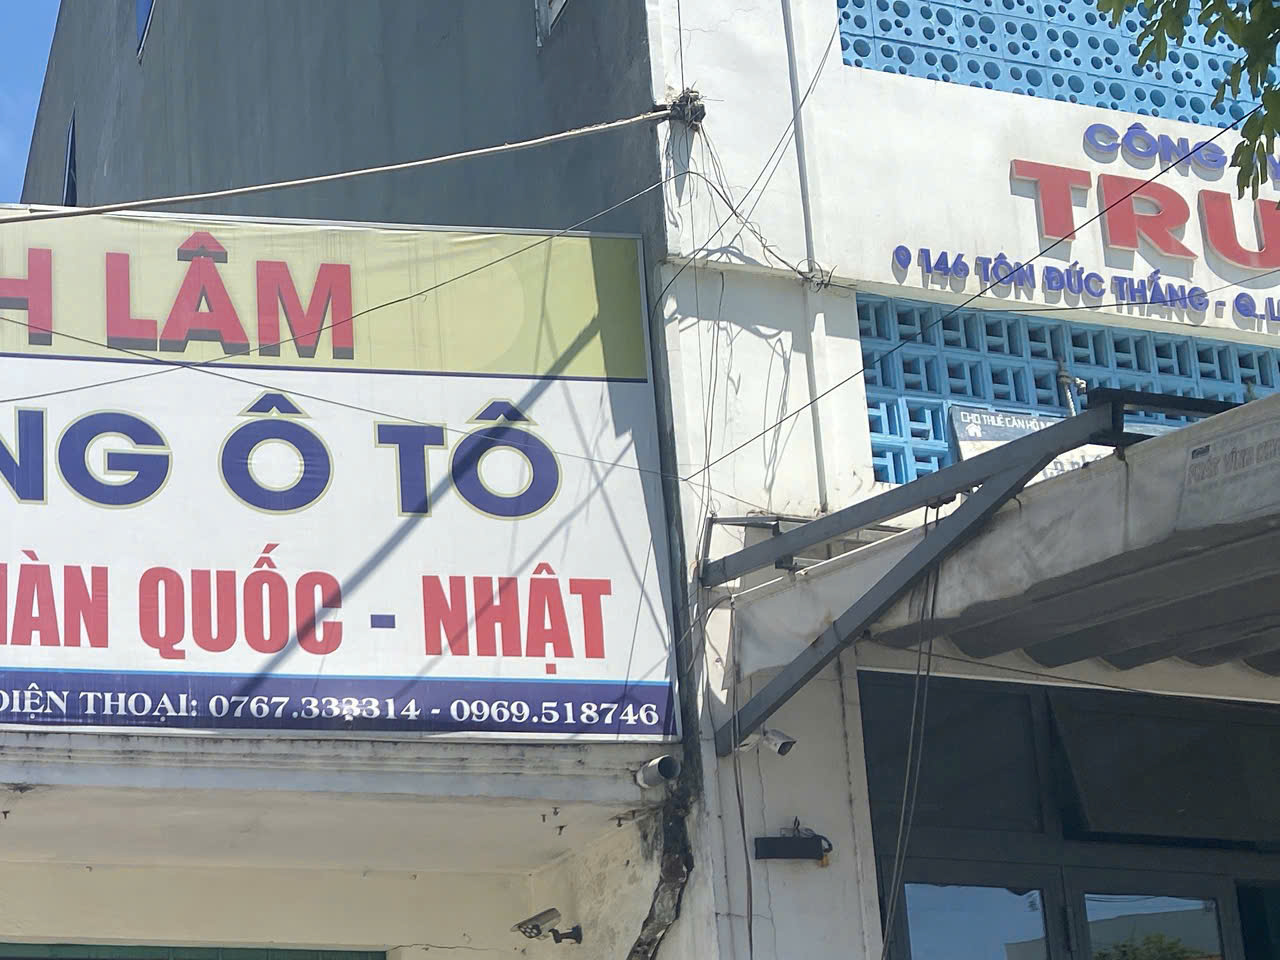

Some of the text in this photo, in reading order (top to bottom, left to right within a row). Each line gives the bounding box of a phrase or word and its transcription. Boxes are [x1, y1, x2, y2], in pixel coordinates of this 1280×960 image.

[1083, 121, 1228, 173] CÔNG
[105, 231, 355, 360] LÂM
[918, 248, 970, 279] 146
[975, 252, 1036, 289] TÔN
[1043, 261, 1107, 298] ĐỨC
[1113, 268, 1209, 312] THẮNG
[218, 389, 334, 514] Ô
[374, 398, 563, 520] TÔ
[138, 542, 343, 659] QUỐC
[422, 562, 612, 675] NHẬT
[79, 691, 198, 722] THOẠI:
[450, 699, 660, 726] 0969.518746
